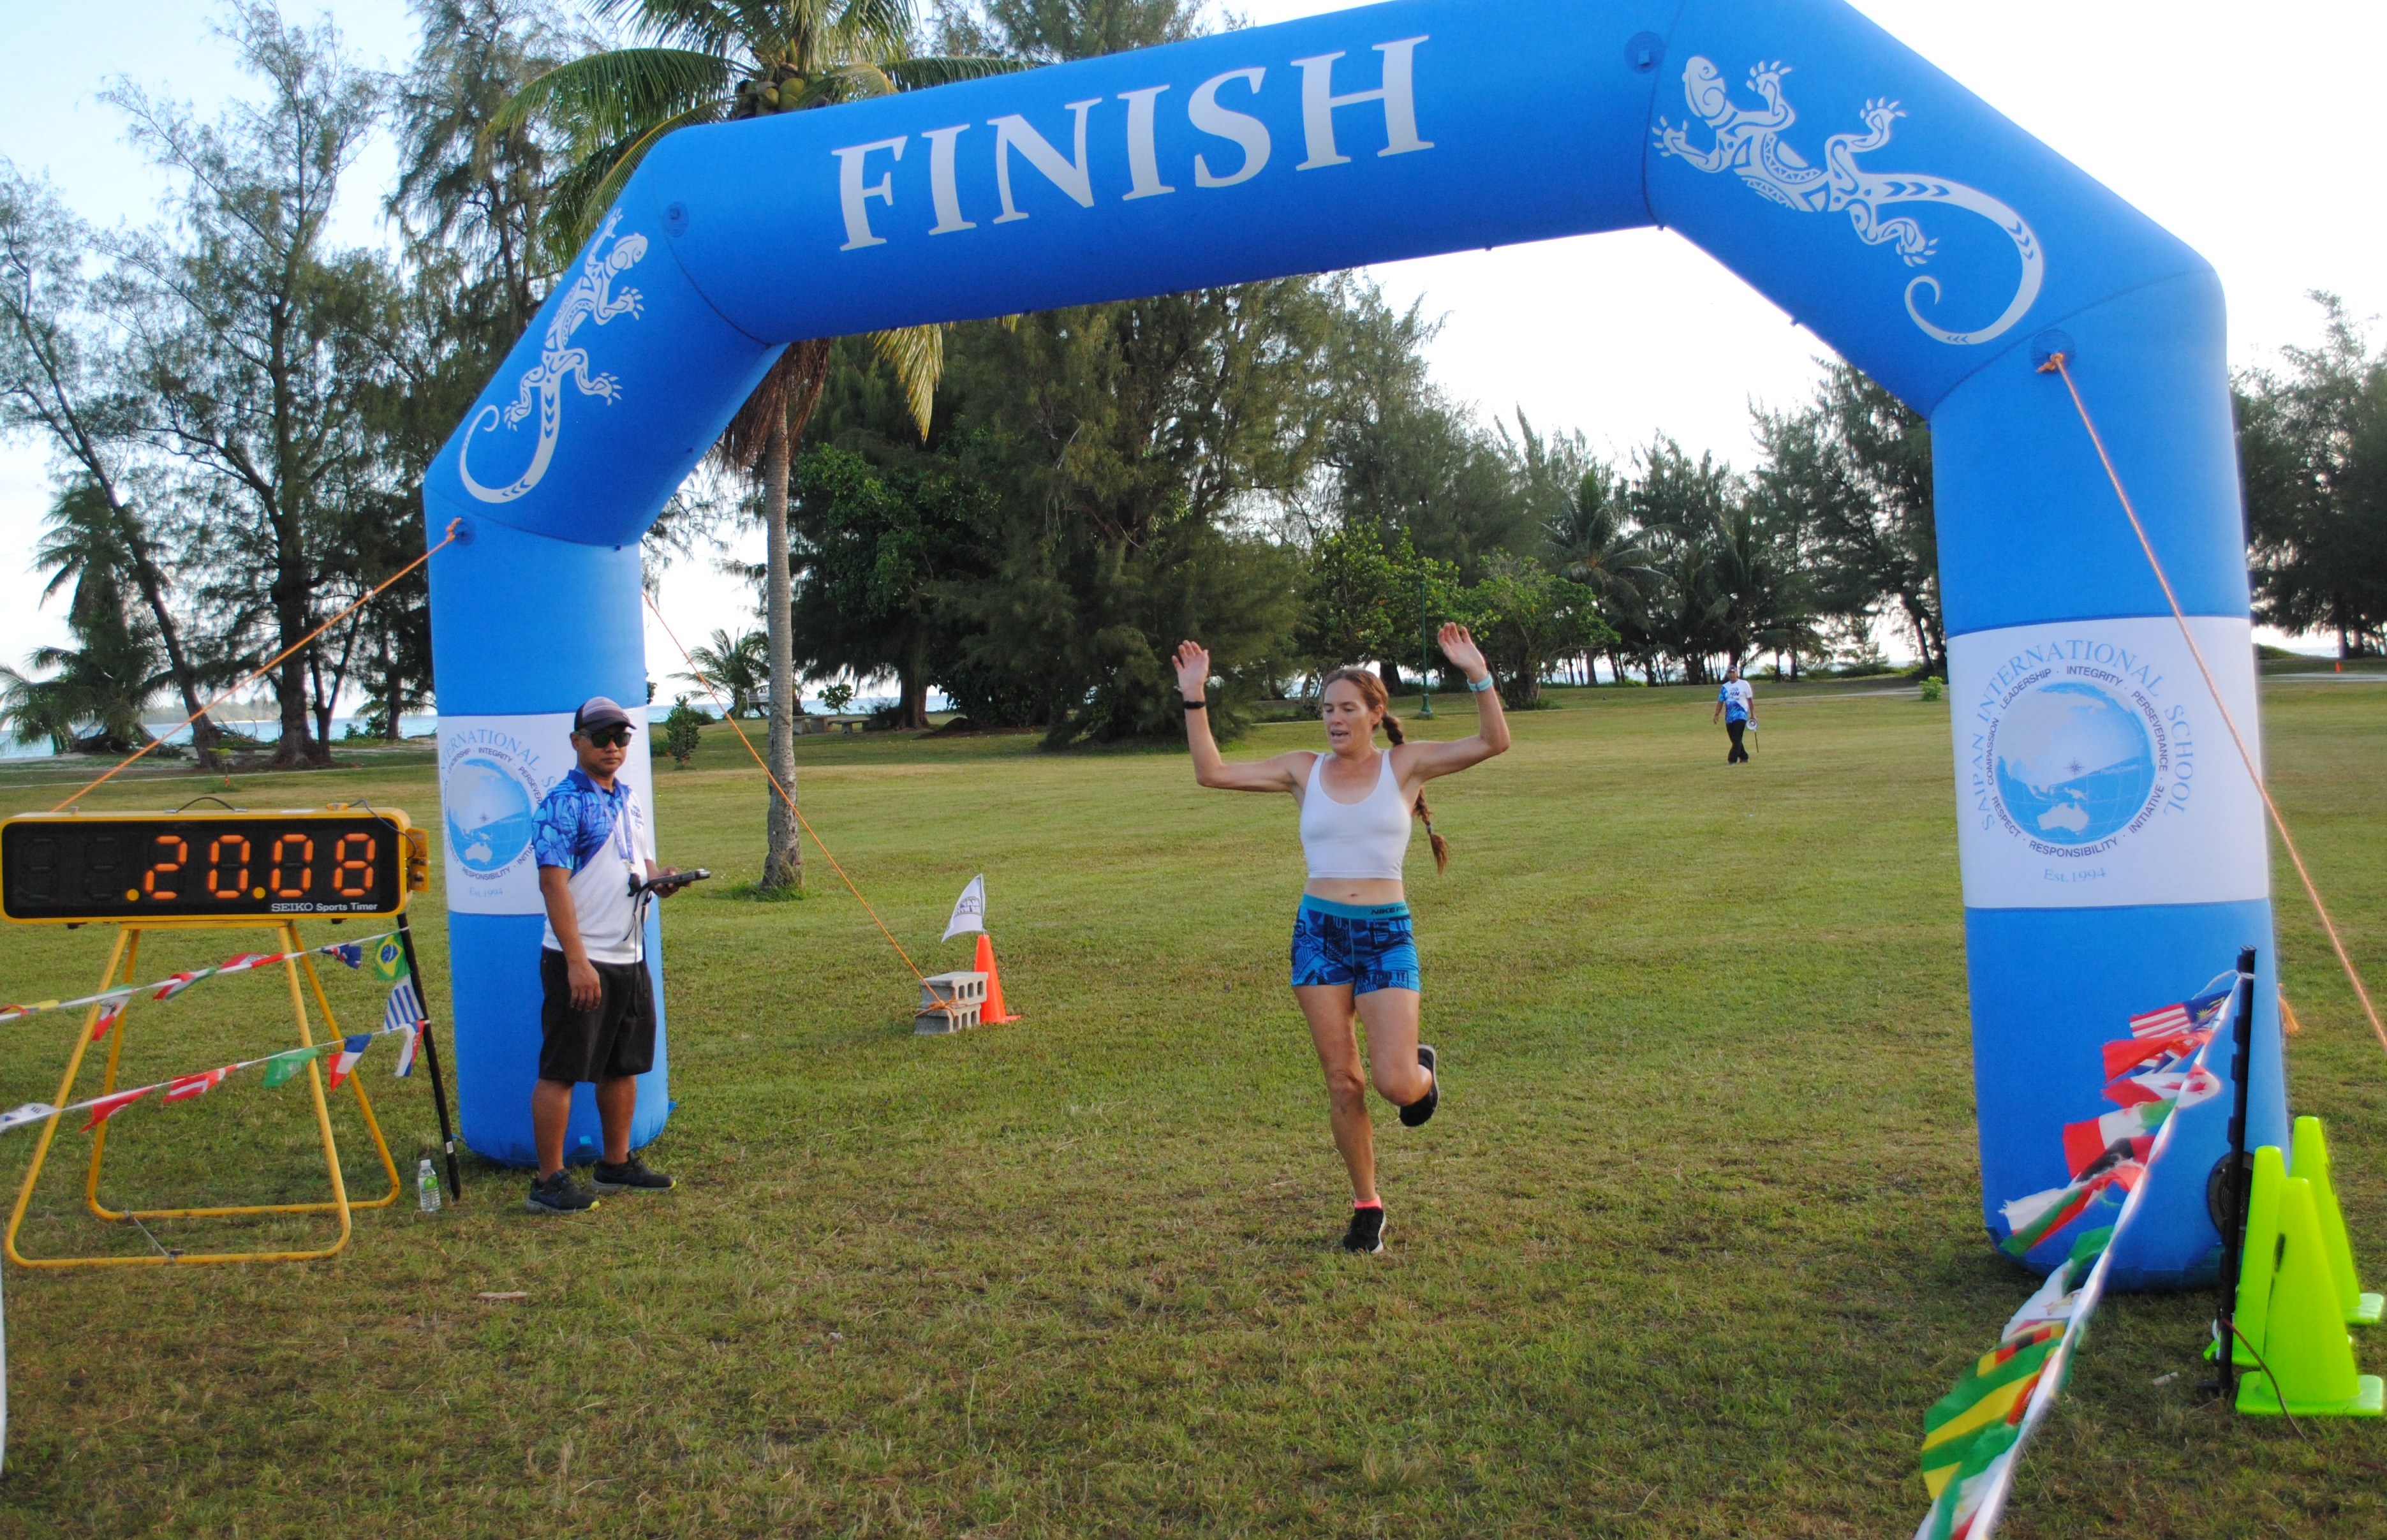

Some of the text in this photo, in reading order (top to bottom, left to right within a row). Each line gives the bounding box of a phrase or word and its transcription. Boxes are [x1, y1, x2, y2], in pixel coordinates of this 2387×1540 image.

[832, 34, 1435, 251] FINISH
[2000, 668, 2051, 709] LEADERSHIP
[2066, 665, 2123, 686] INTEGRITY
[1972, 640, 2194, 831] SAIPAN INTERNATIONAL SCHOOL
[1986, 717, 1999, 785] COMPASSION
[2131, 690, 2168, 772] PERSEVERANCE
[478, 747, 513, 763] INTEGRITY
[1992, 796, 2021, 838] RESPECT
[2128, 784, 2164, 834] INITIATIVE
[2029, 836, 2118, 857] RESPONSIBILITY
[462, 866, 511, 880] RESPONSIBILITY
[271, 902, 378, 912] SEIKO Sports Timer
